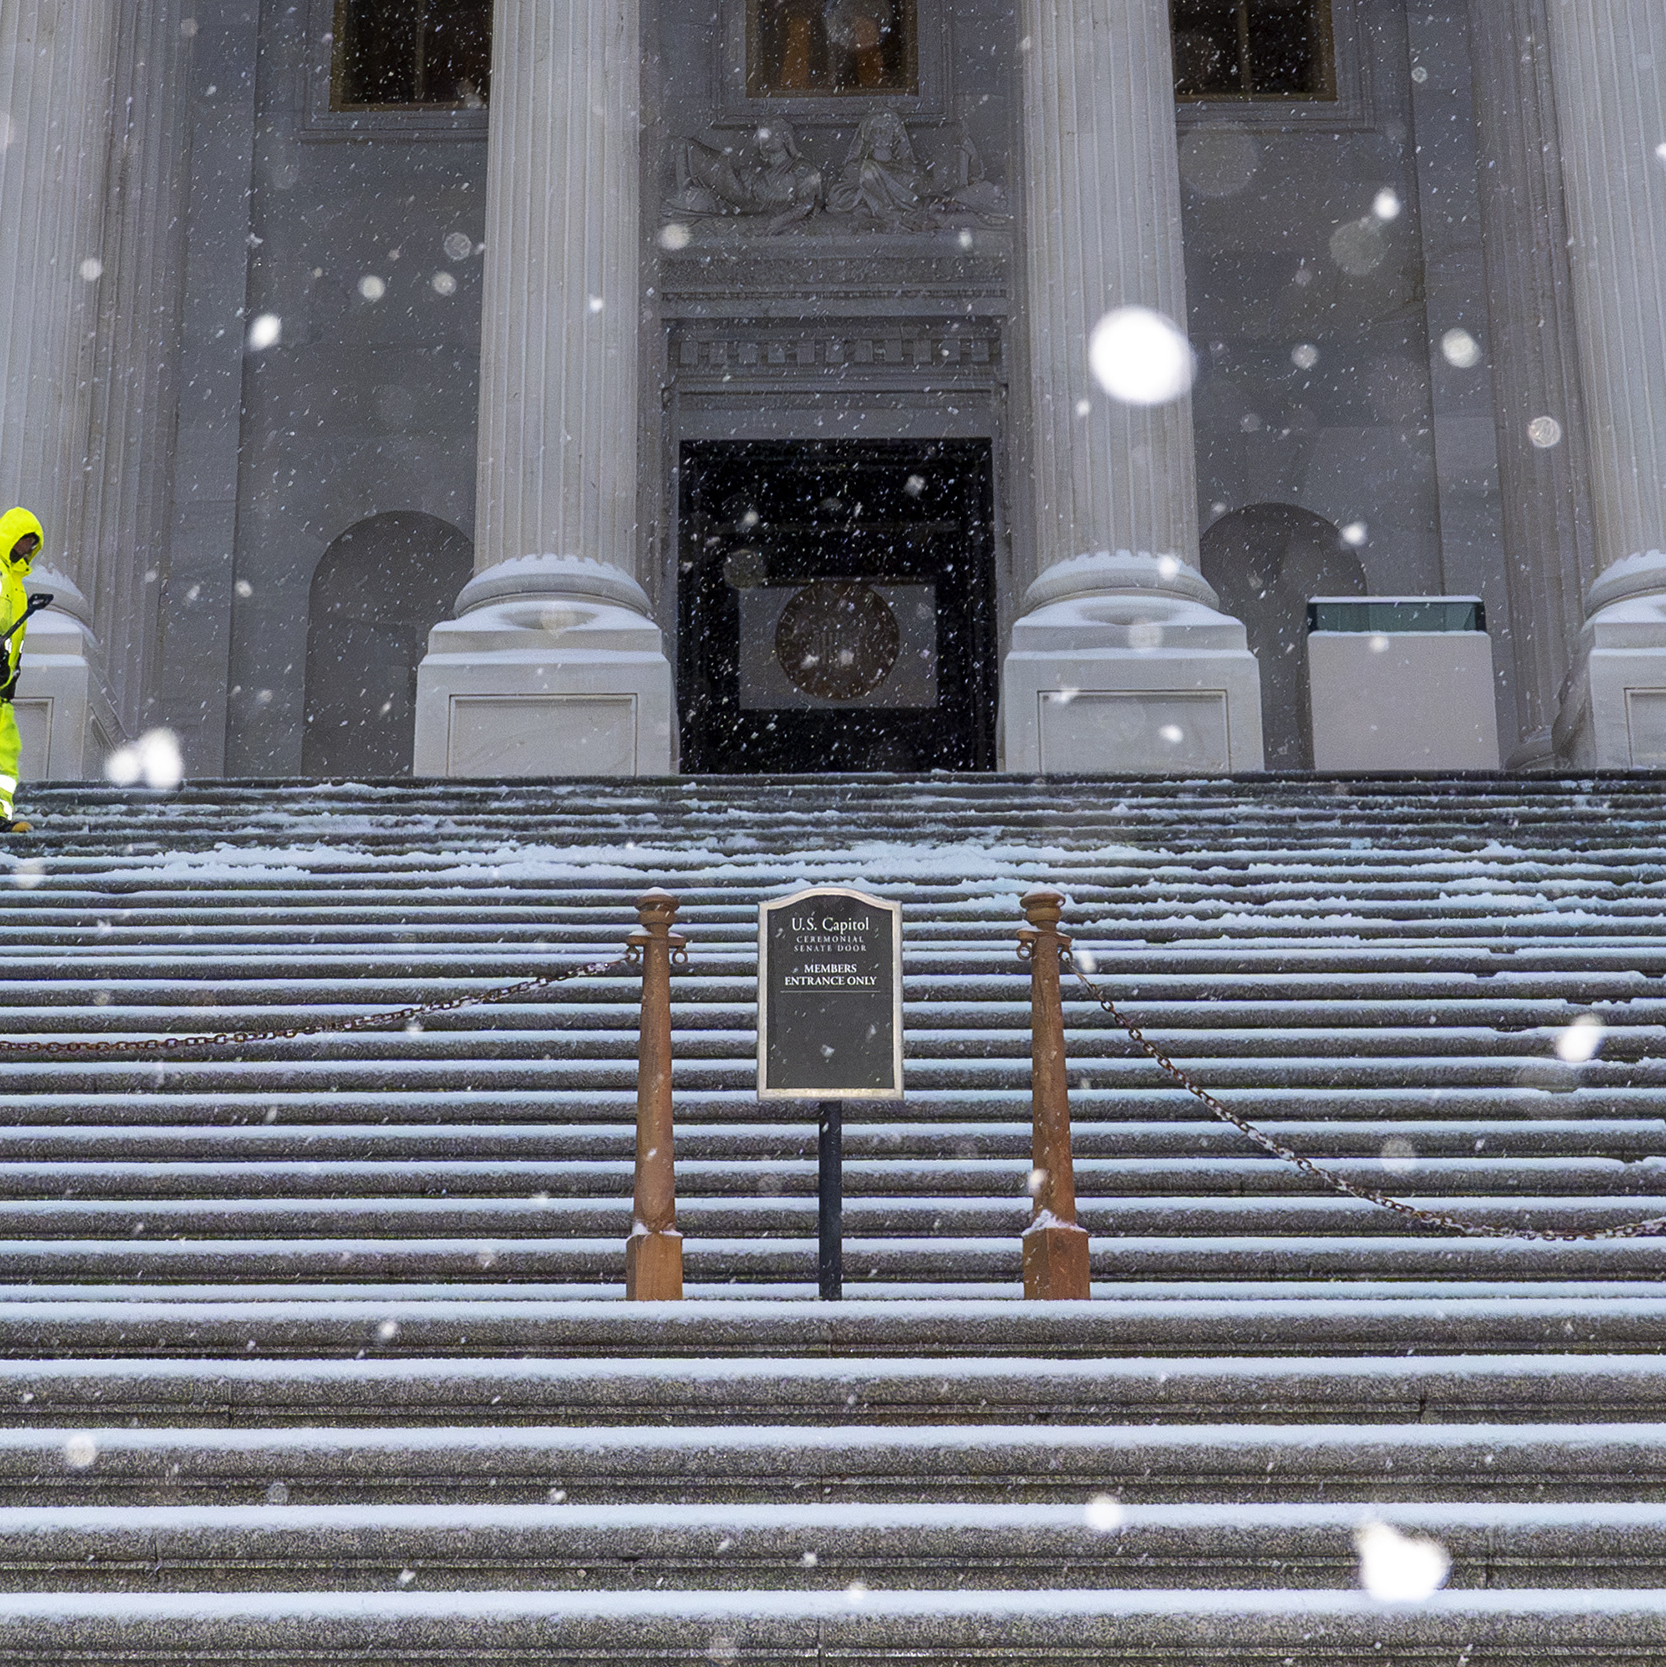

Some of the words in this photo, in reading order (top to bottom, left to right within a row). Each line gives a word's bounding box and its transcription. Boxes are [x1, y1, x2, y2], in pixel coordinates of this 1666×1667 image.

[791, 917, 818, 931] U.S.
[822, 916, 870, 935] Capitol
[796, 935, 864, 943] CEREMONIAL
[794, 944, 833, 952] SENATE
[837, 944, 867, 952] DOOR
[804, 963, 858, 973] MEMBERS
[784, 976, 845, 986] ENTRANCE
[846, 976, 878, 986] ONLY
